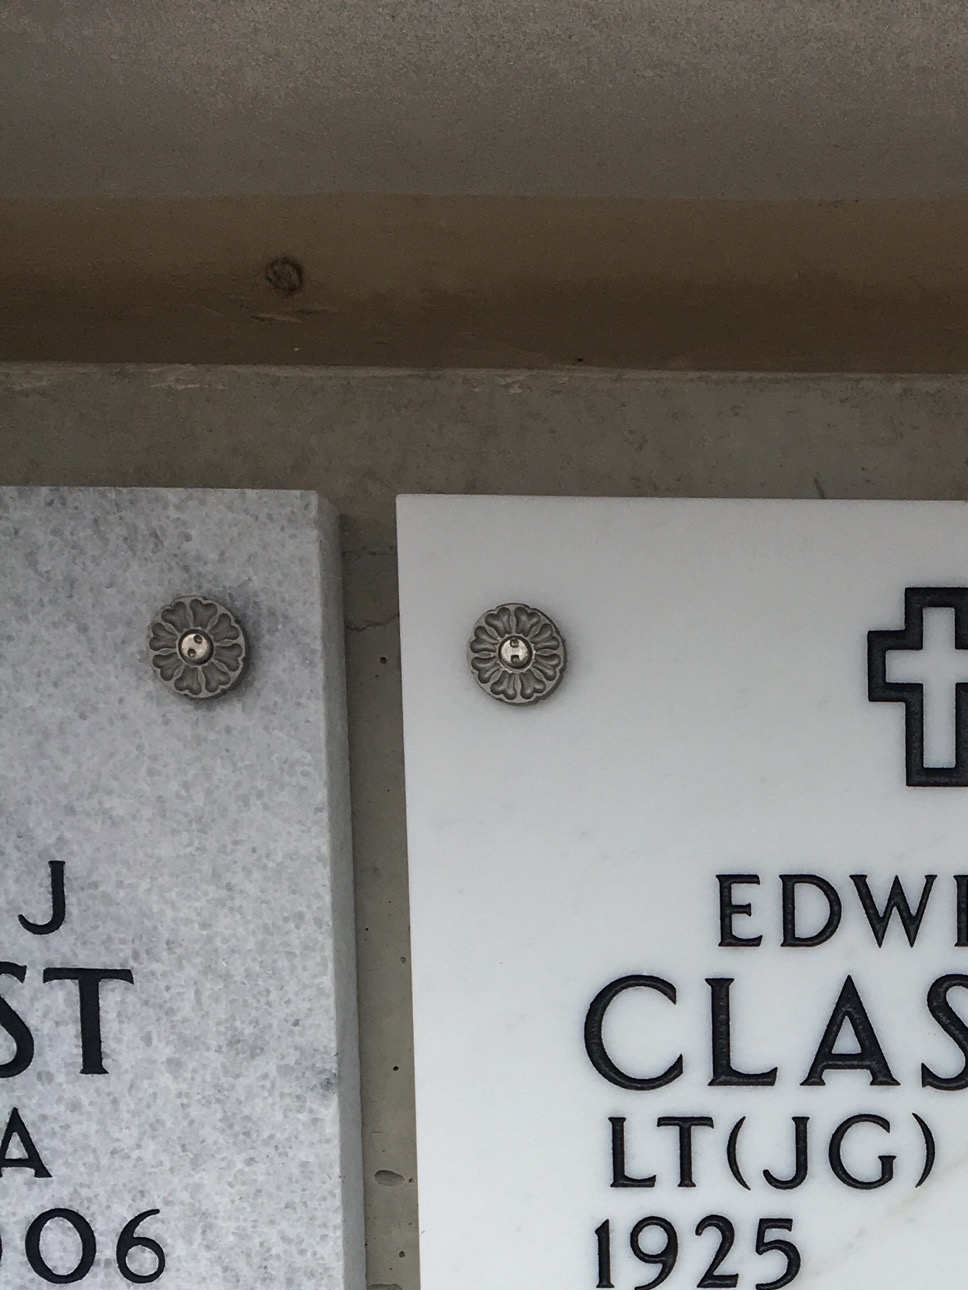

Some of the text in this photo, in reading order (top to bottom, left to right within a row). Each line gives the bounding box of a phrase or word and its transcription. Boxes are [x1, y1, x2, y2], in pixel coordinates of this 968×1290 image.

[17, 859, 67, 936] J
[0, 960, 135, 1079] ST
[0, 1106, 53, 1179] A
[607, 1112, 936, 1191] LT(JG)
[0, 1207, 166, 1285] 06
